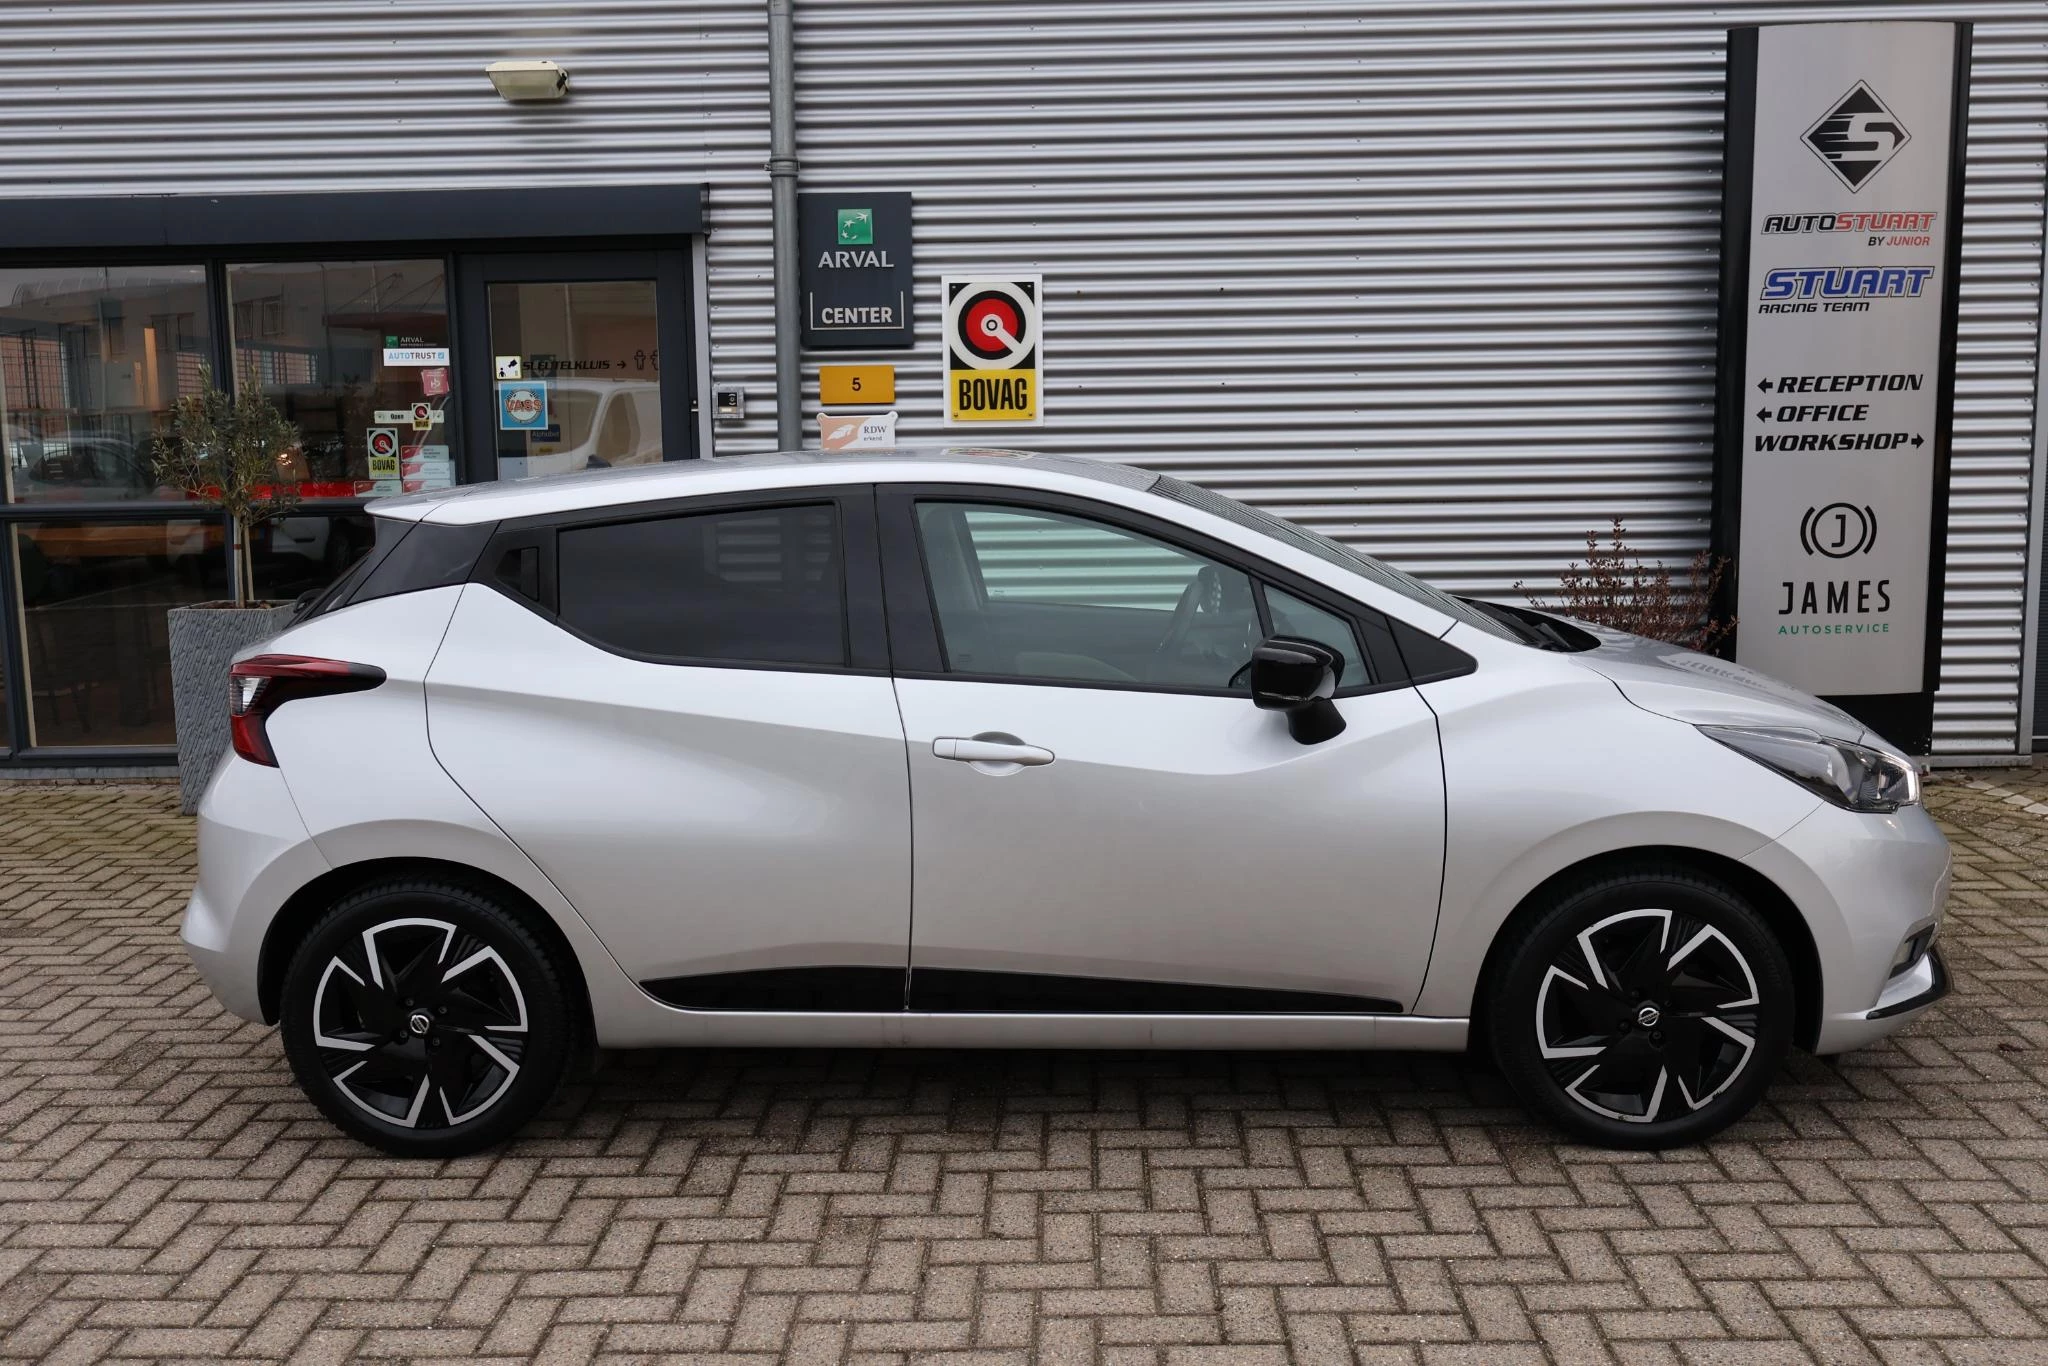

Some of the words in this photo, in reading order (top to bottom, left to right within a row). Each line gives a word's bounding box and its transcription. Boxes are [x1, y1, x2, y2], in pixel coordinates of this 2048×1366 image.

[1762, 213, 1936, 233] AUTOSTUART
[1868, 236, 1885, 247] BY
[1886, 236, 1930, 246] JUNIOR
[817, 250, 895, 269] ARVAL
[1761, 267, 1934, 300] STUART
[821, 307, 893, 324] CENTER
[1758, 303, 1818, 314] RACING
[1823, 302, 1870, 313] TEAM
[388, 352, 437, 360] AUTOTRUST
[851, 377, 862, 392] 5
[1776, 374, 1924, 393] RECEPTION
[958, 377, 1028, 411] BOVAG
[1776, 404, 1870, 422] OFFICE
[863, 425, 887, 435] RDW
[1755, 433, 1909, 451] WORKSHOP
[372, 459, 396, 471] BOVAG
[1778, 579, 1891, 614] JAMES
[1777, 623, 1890, 635] AUTOSERVICE
